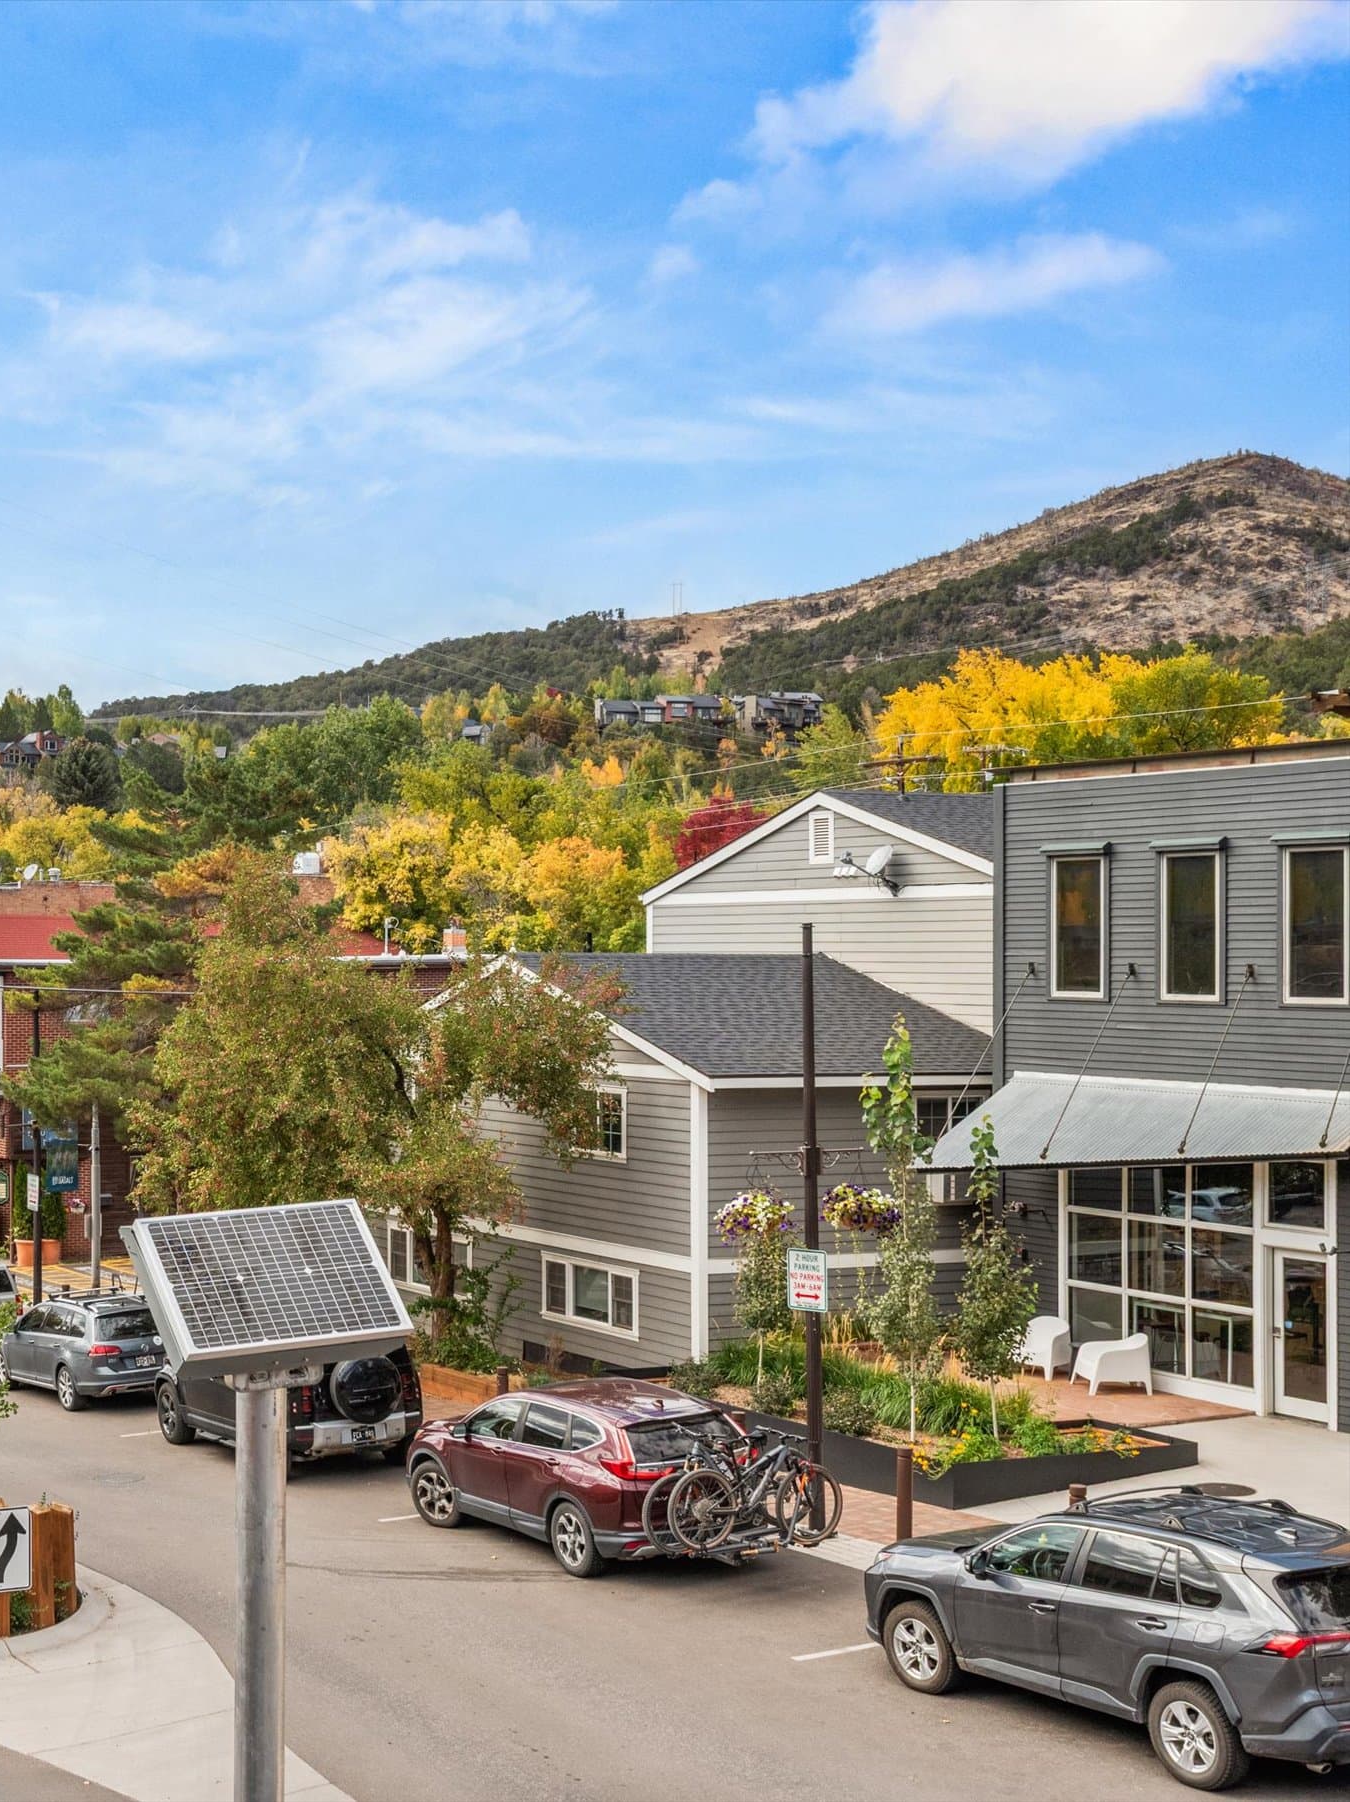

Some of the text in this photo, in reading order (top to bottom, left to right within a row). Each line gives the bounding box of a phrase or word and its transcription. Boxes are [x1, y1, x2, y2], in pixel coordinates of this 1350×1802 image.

[795, 1253, 818, 1262] 2 HOUR
[793, 1263, 820, 1272] PARKING
[790, 1272, 824, 1282] NO PARKING
